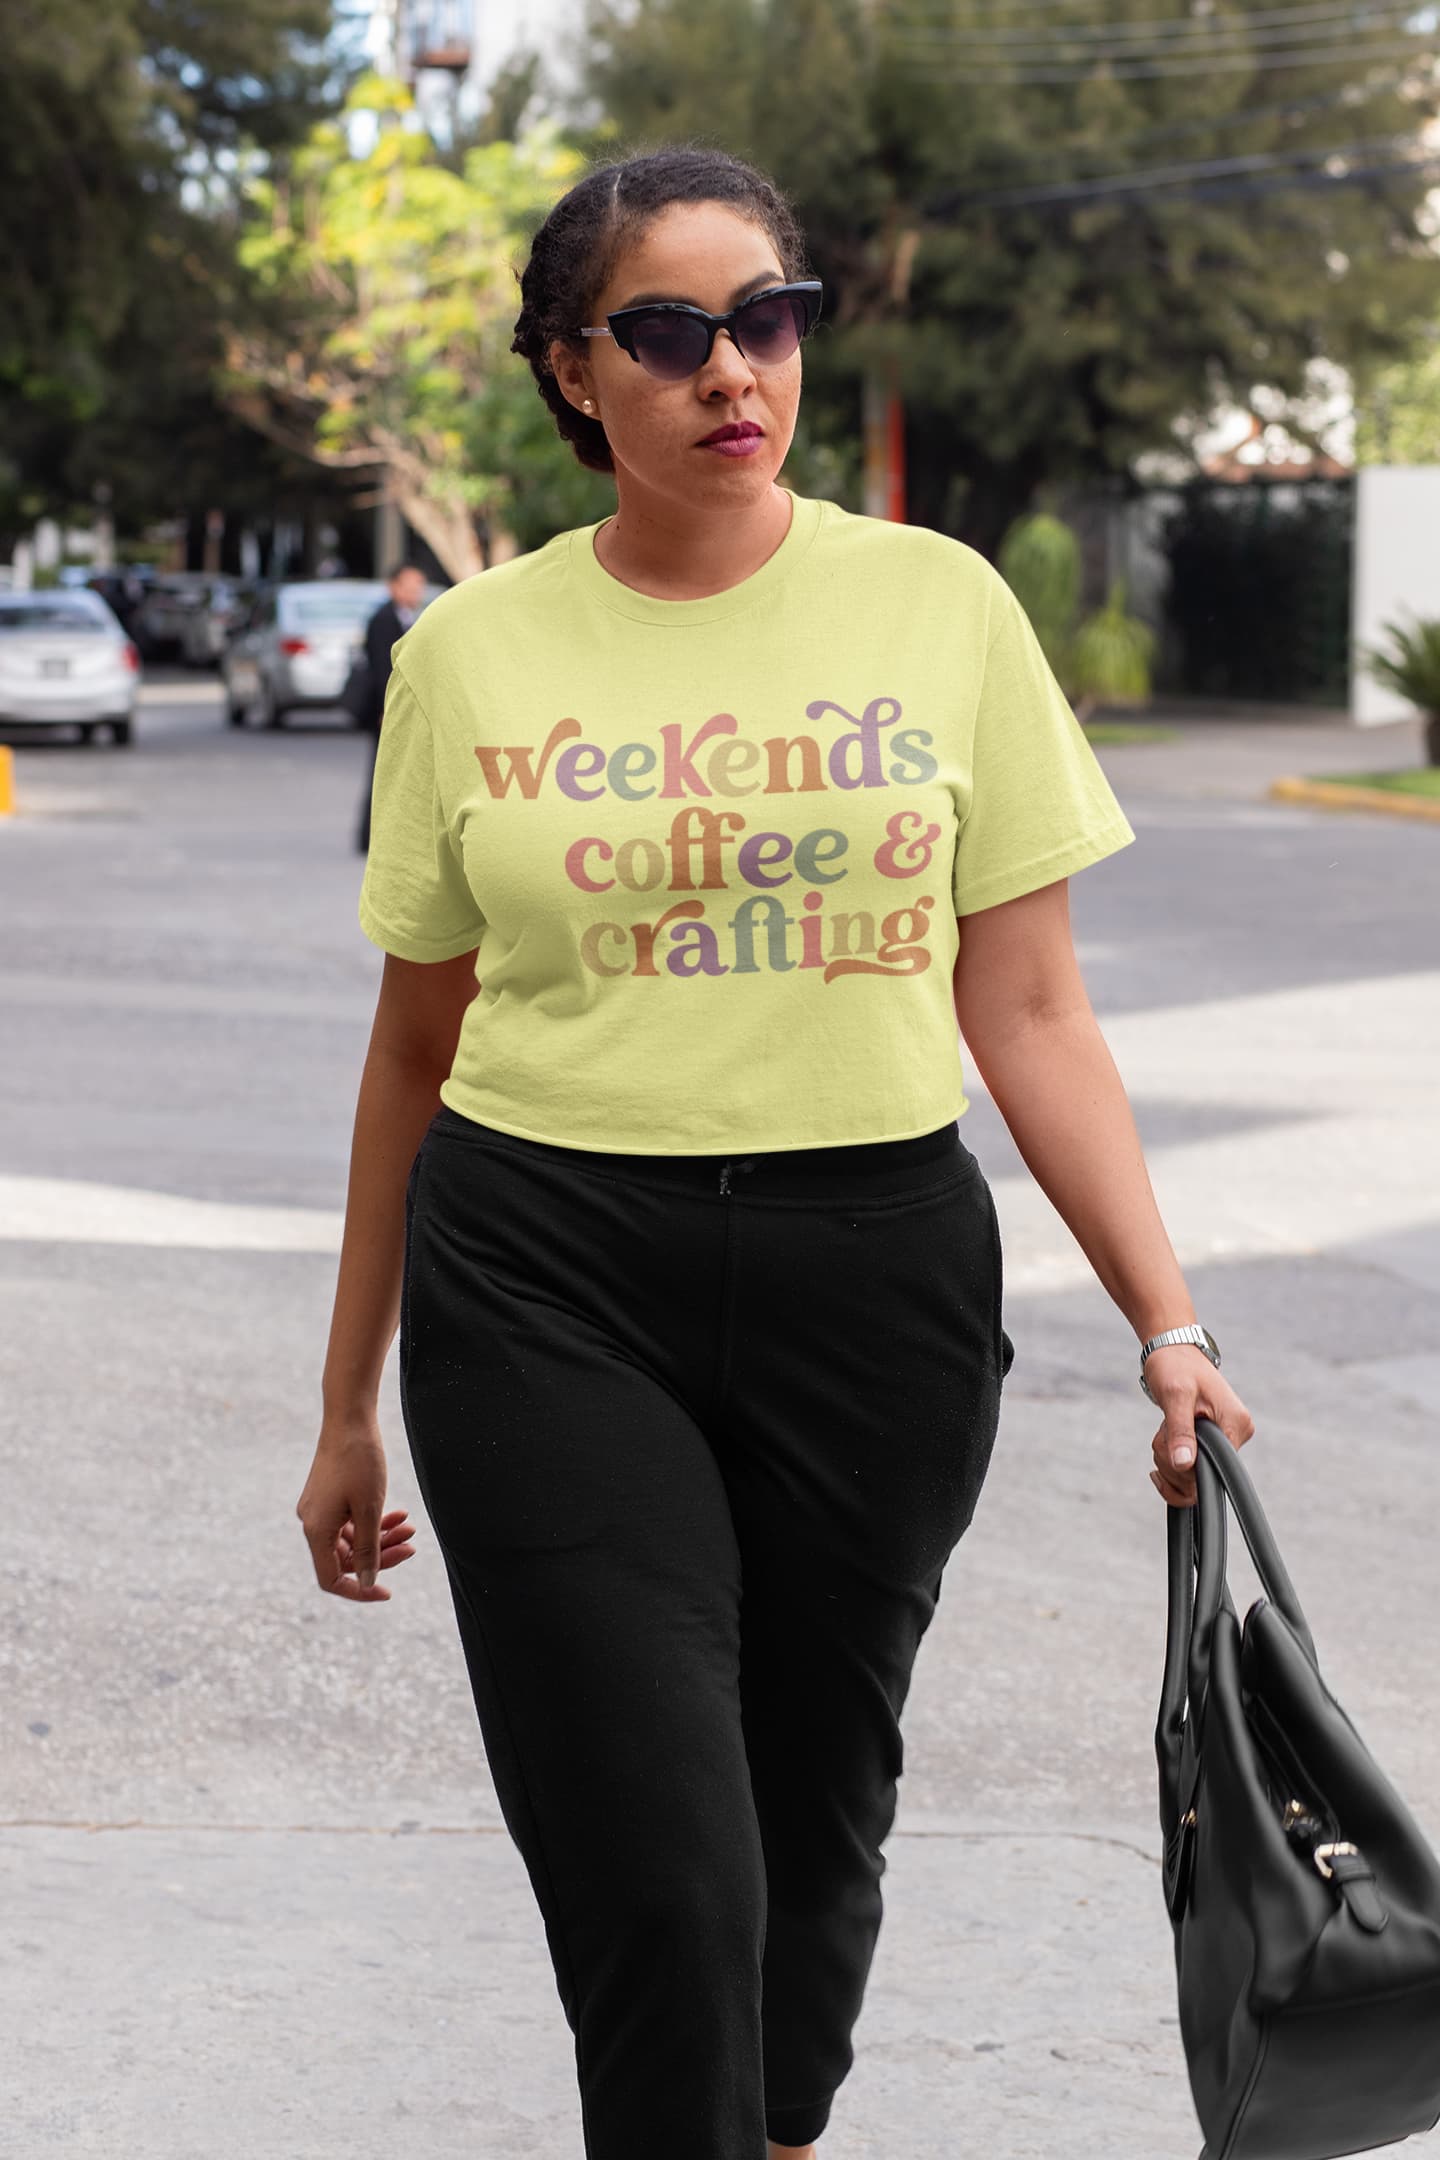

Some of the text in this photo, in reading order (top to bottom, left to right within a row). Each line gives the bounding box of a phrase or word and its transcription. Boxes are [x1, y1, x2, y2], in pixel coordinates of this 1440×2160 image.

[474, 697, 939, 802] weekends
[565, 806, 942, 893] coffee &
[580, 892, 935, 985] crafting
